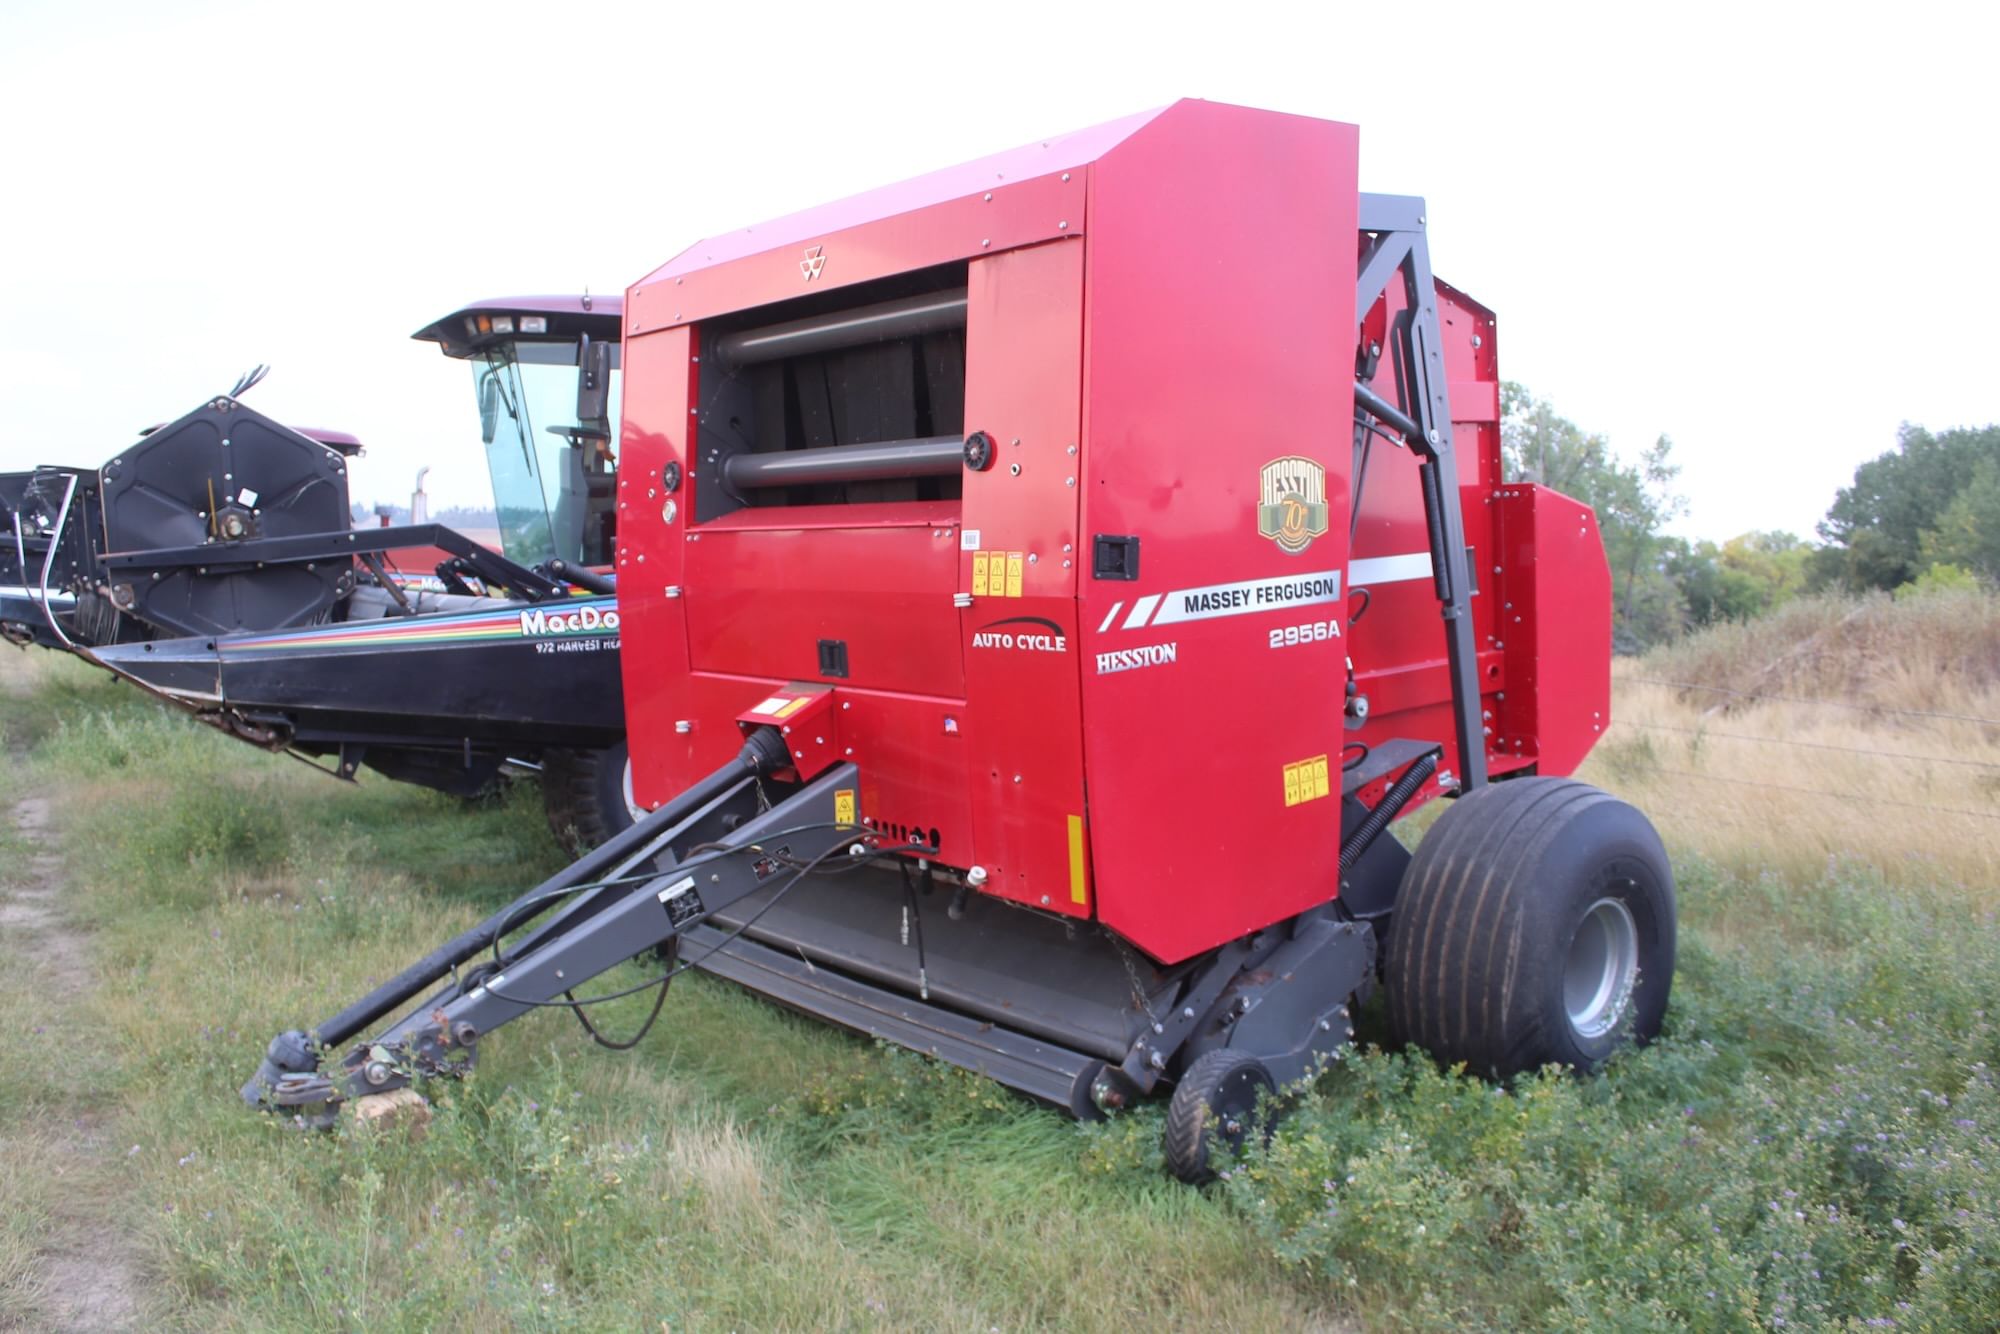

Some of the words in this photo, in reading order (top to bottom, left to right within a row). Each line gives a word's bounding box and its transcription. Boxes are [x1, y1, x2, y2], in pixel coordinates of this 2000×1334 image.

[1263, 459, 1323, 506] HESSTON
[1184, 589, 1251, 614] MASSEY
[1256, 578, 1334, 606] FERGUSON
[535, 642, 555, 654] 972
[556, 639, 601, 652] HARVEST
[972, 633, 1013, 649] AUTO
[1017, 634, 1067, 652] CYCLE
[1269, 619, 1341, 649] 2956A
[1096, 642, 1177, 675] HESSTON
